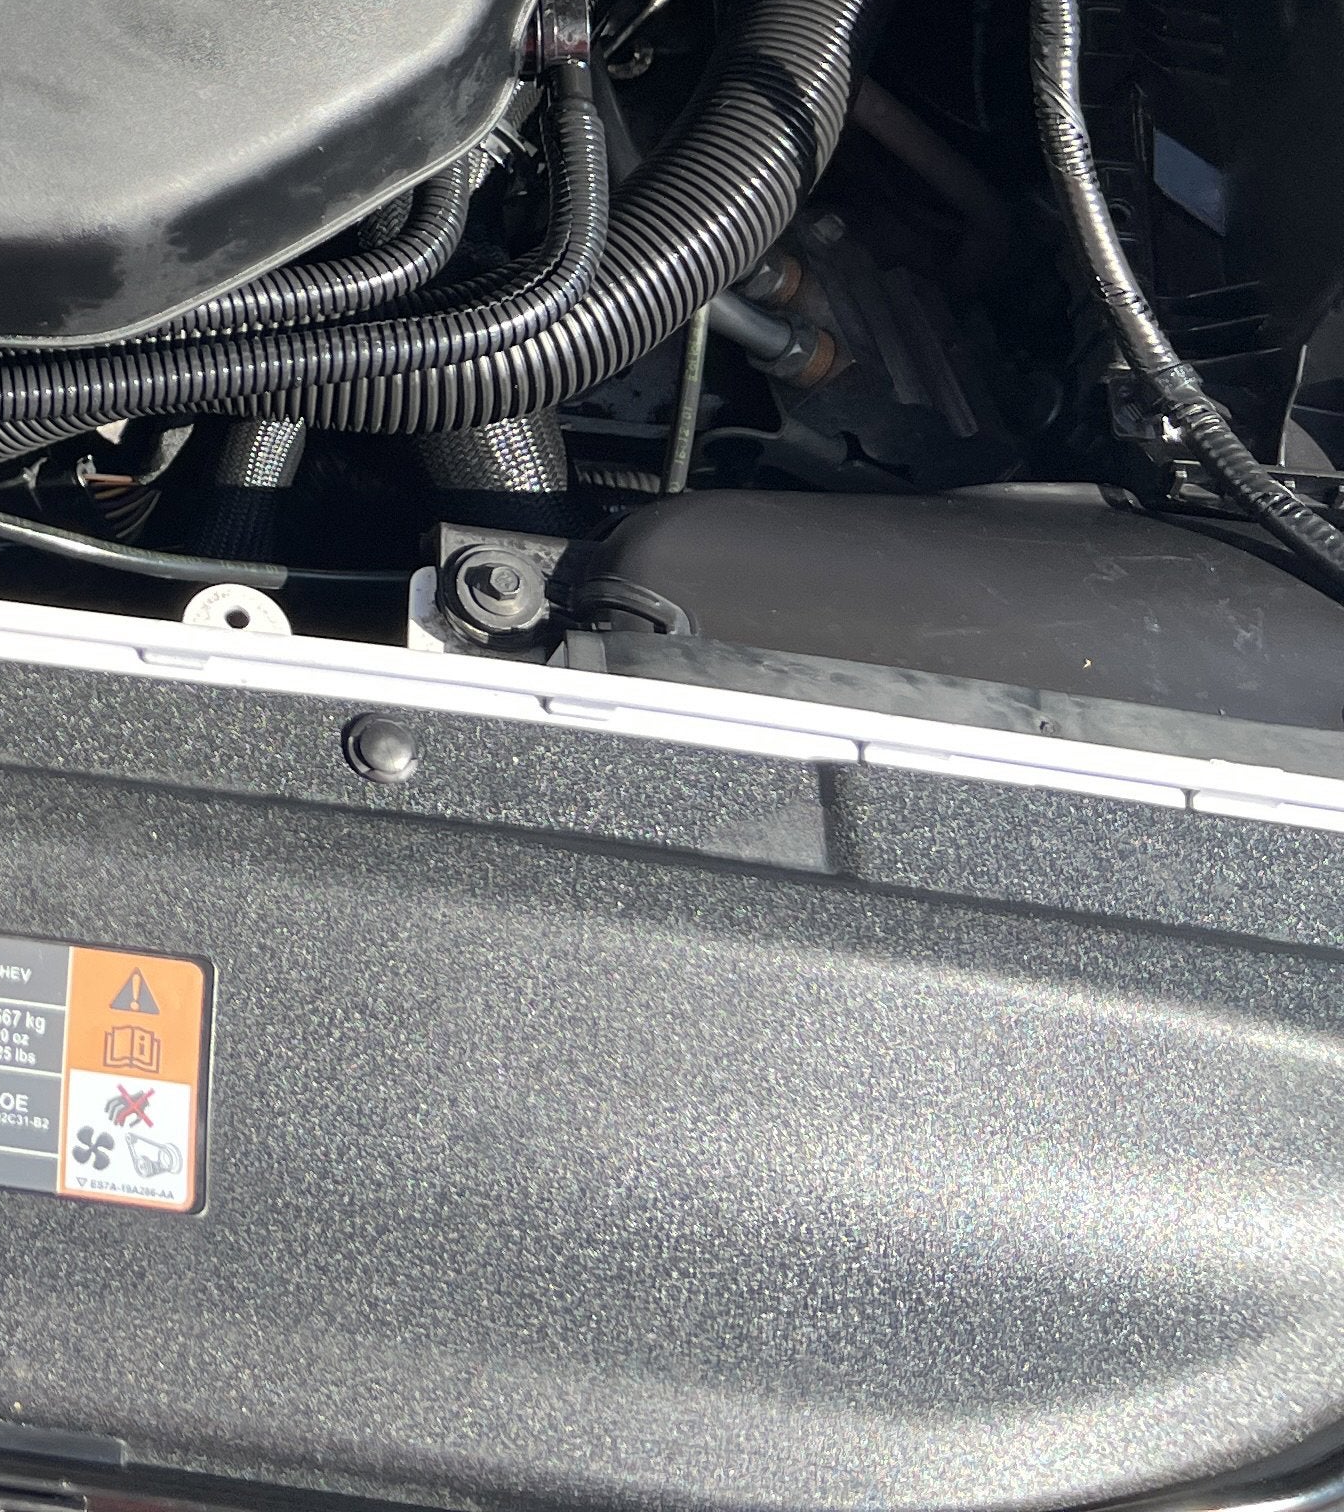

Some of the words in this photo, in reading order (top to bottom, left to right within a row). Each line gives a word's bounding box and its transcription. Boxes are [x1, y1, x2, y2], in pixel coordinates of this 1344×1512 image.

[0, 964, 32, 985] HEV
[25, 1011, 46, 1035] kg
[12, 1031, 30, 1046] oz
[14, 1047, 37, 1066] lbs
